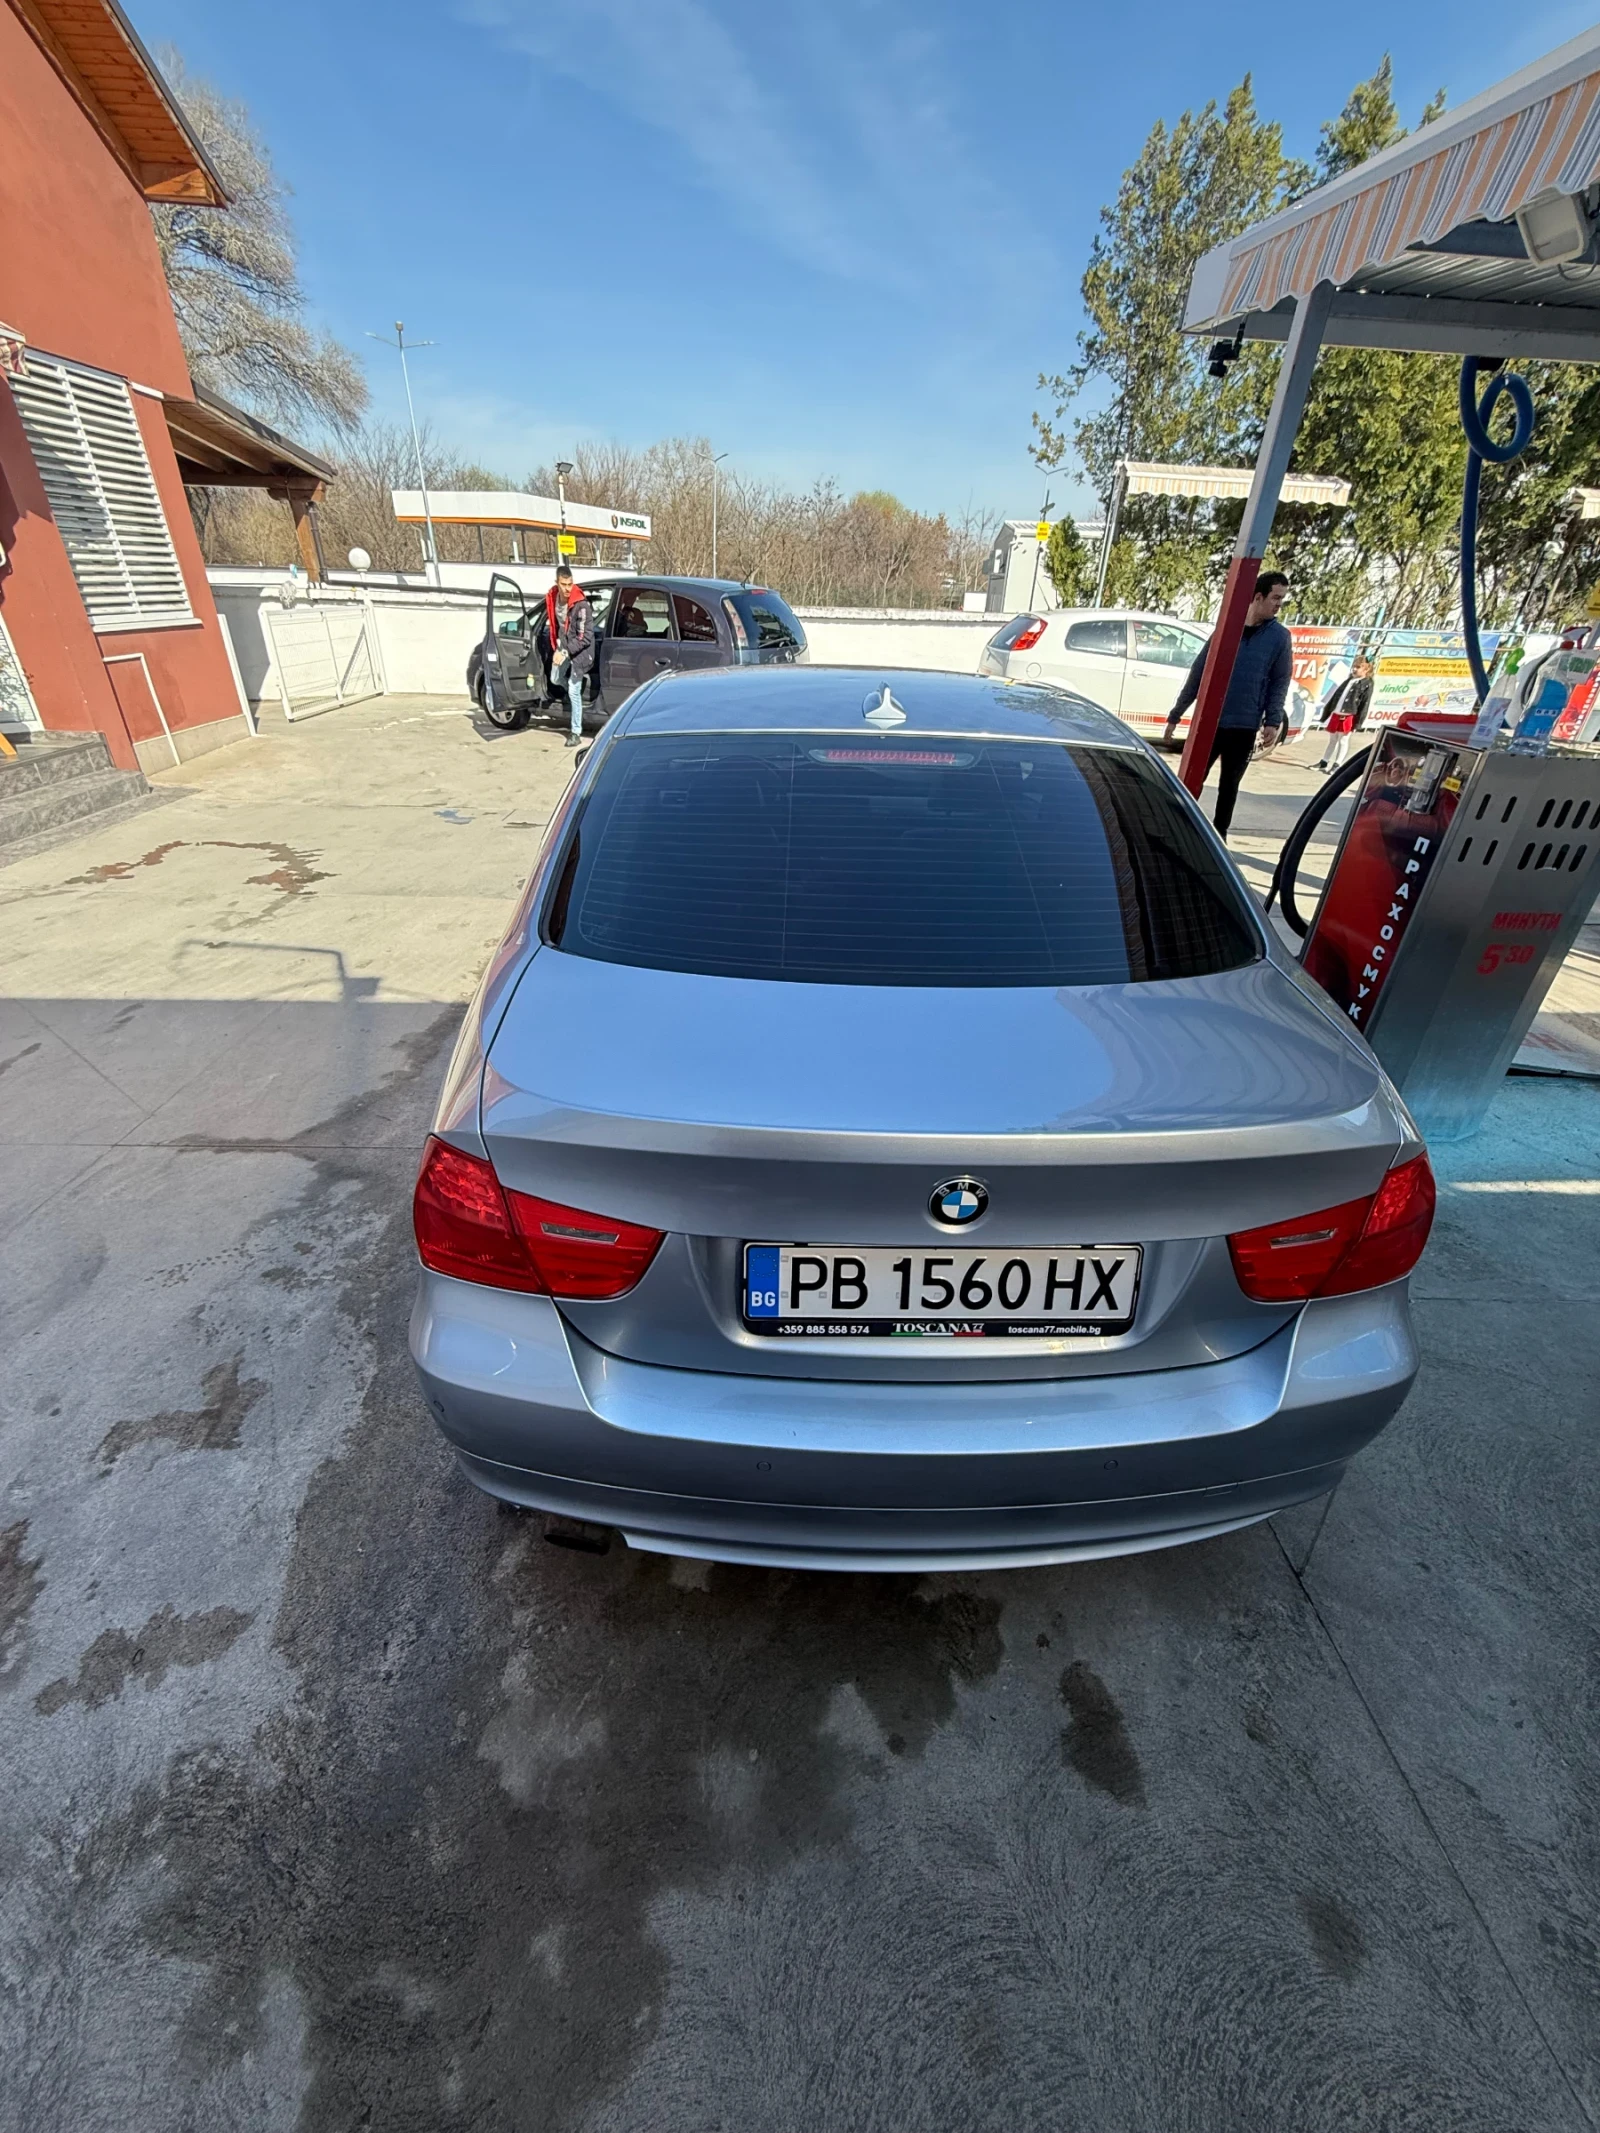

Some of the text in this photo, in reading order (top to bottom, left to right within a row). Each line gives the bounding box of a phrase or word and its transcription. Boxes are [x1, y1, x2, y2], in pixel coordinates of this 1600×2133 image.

[1491, 912, 1563, 931] МИНУТИ
[938, 1181, 987, 1199] BMW
[790, 1256, 1125, 1310] PB 1560 HX
[751, 1291, 776, 1308] BG
[777, 1325, 869, 1335] +359 885 558 574
[1008, 1325, 1101, 1336] toscana77.mobile.bg
